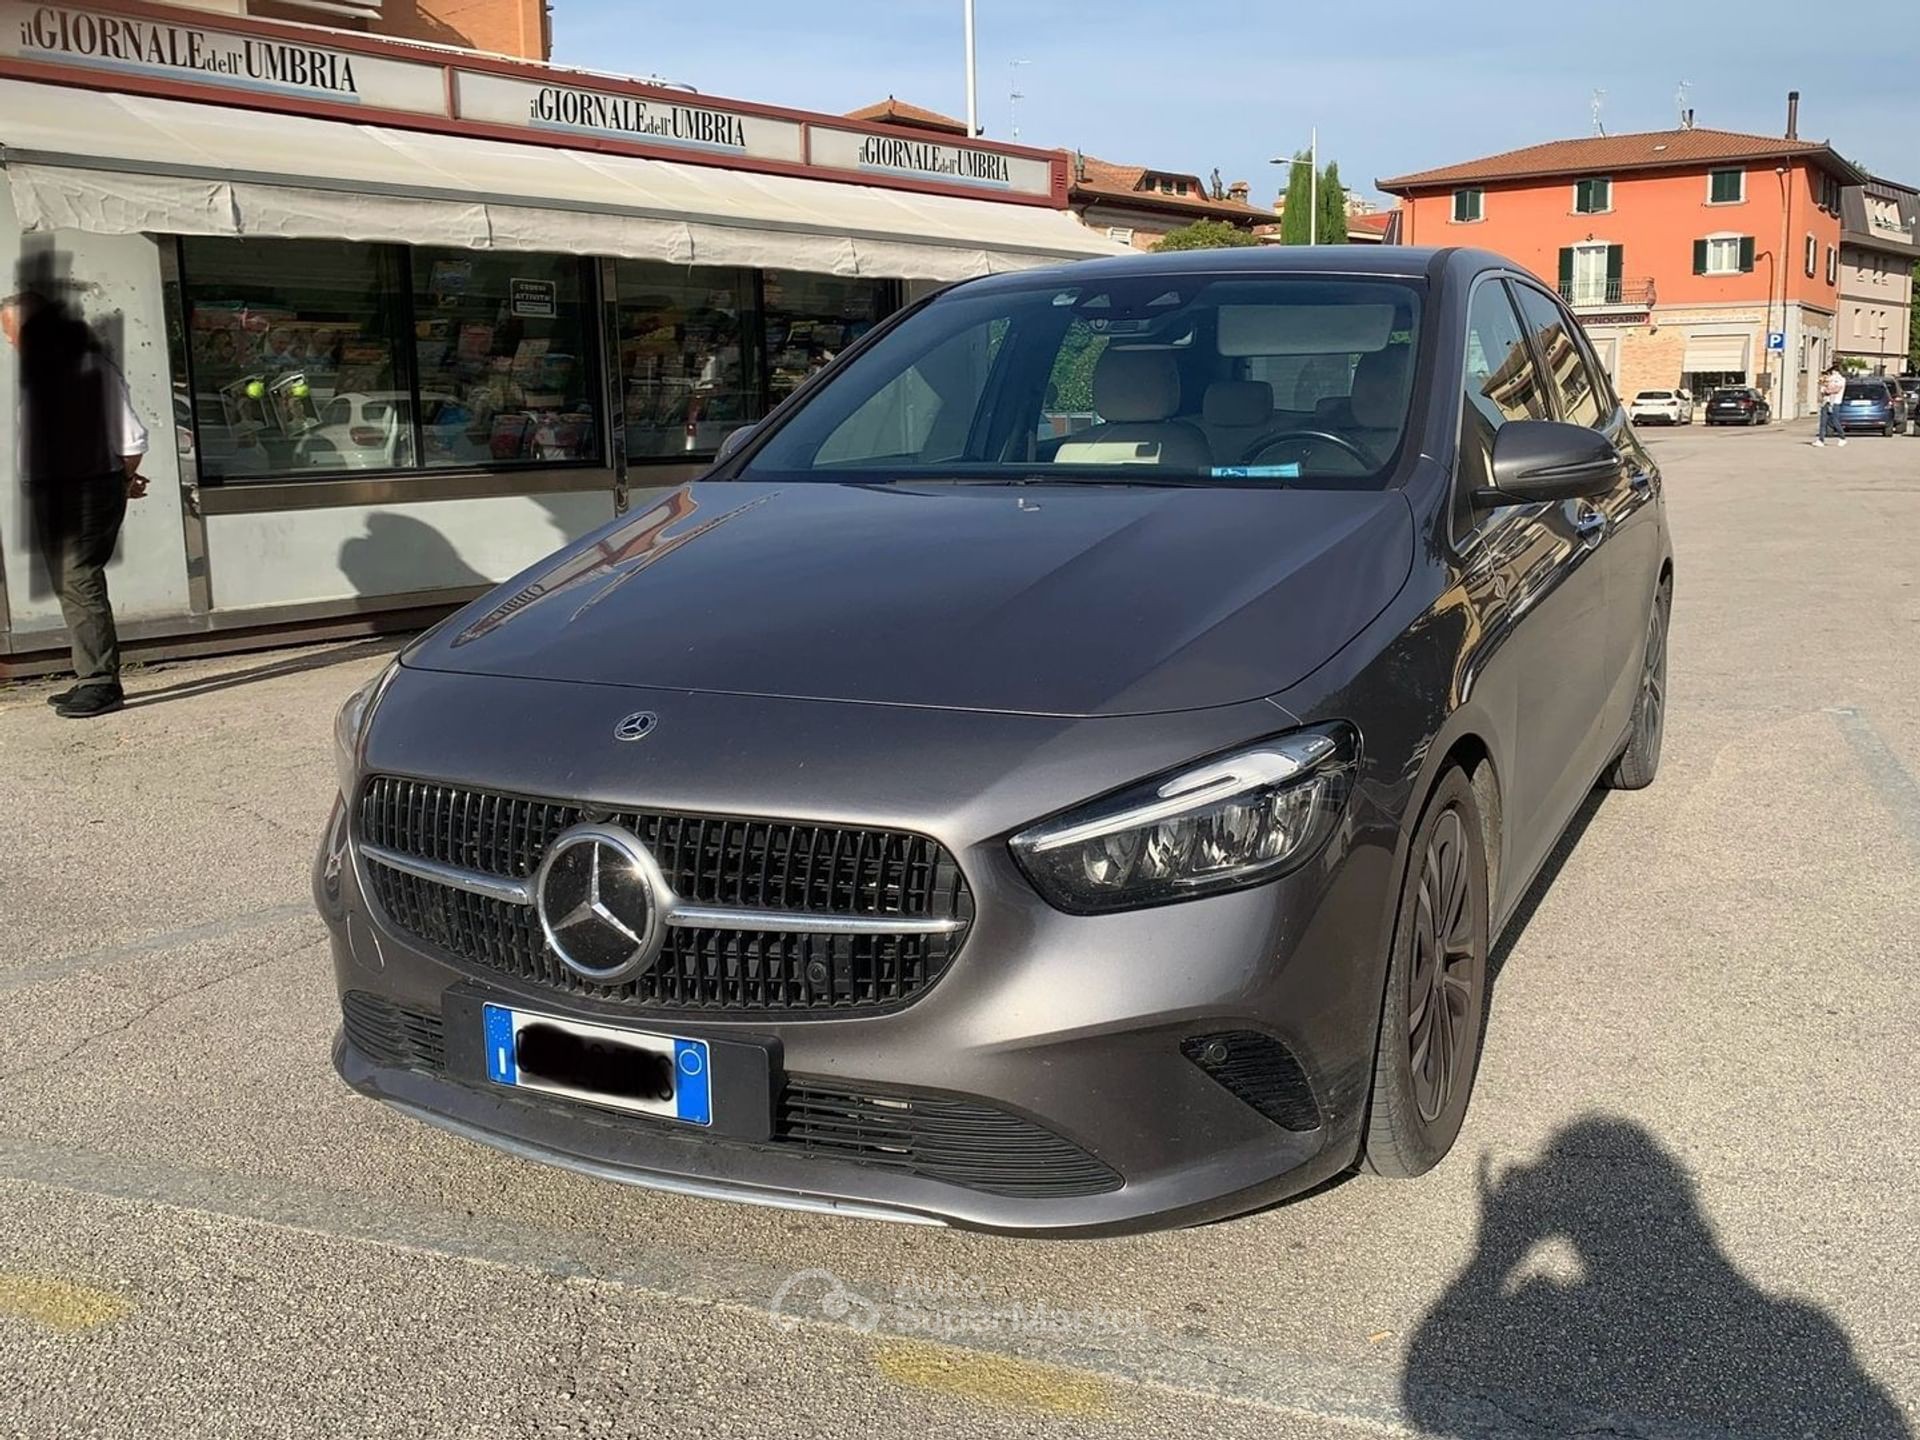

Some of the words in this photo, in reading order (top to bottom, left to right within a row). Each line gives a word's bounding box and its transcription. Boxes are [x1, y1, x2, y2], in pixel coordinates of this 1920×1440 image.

[33, 7, 206, 70] GIORNALE
[538, 87, 647, 133] GIORNALE
[865, 136, 941, 171] GIORNALE
[1770, 334, 1782, 348] P
